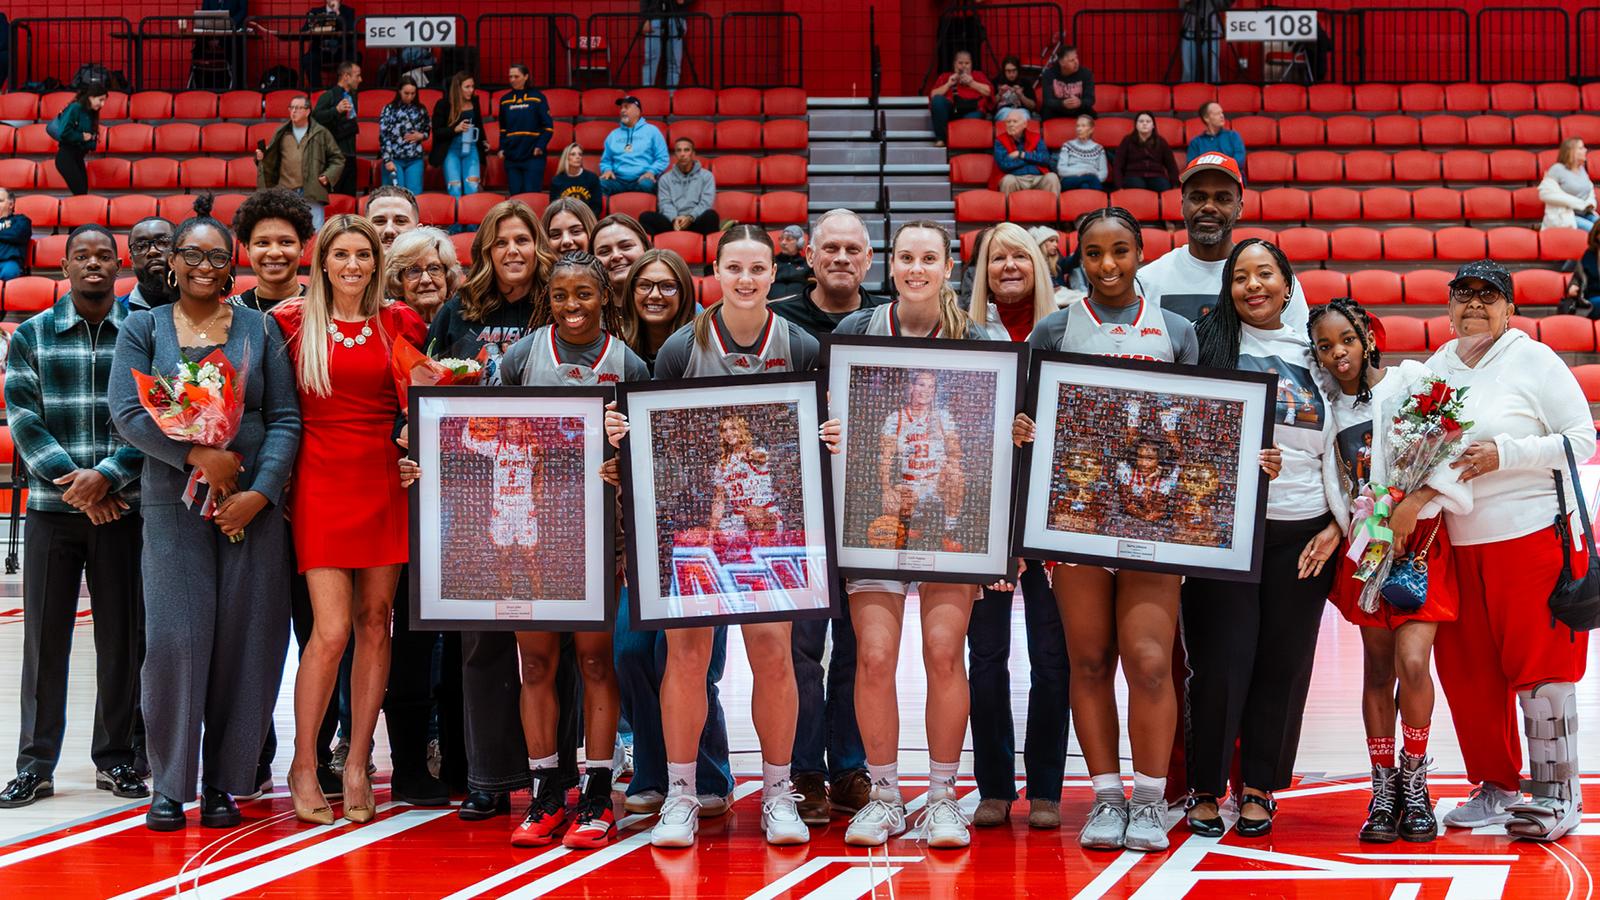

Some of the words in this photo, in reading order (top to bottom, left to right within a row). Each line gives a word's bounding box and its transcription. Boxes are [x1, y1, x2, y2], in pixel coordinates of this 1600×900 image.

[369, 26, 396, 38] SEC
[403, 20, 452, 42] 109
[1230, 21, 1257, 32] SEC
[1264, 14, 1312, 36] 108
[914, 444, 929, 459] 23
